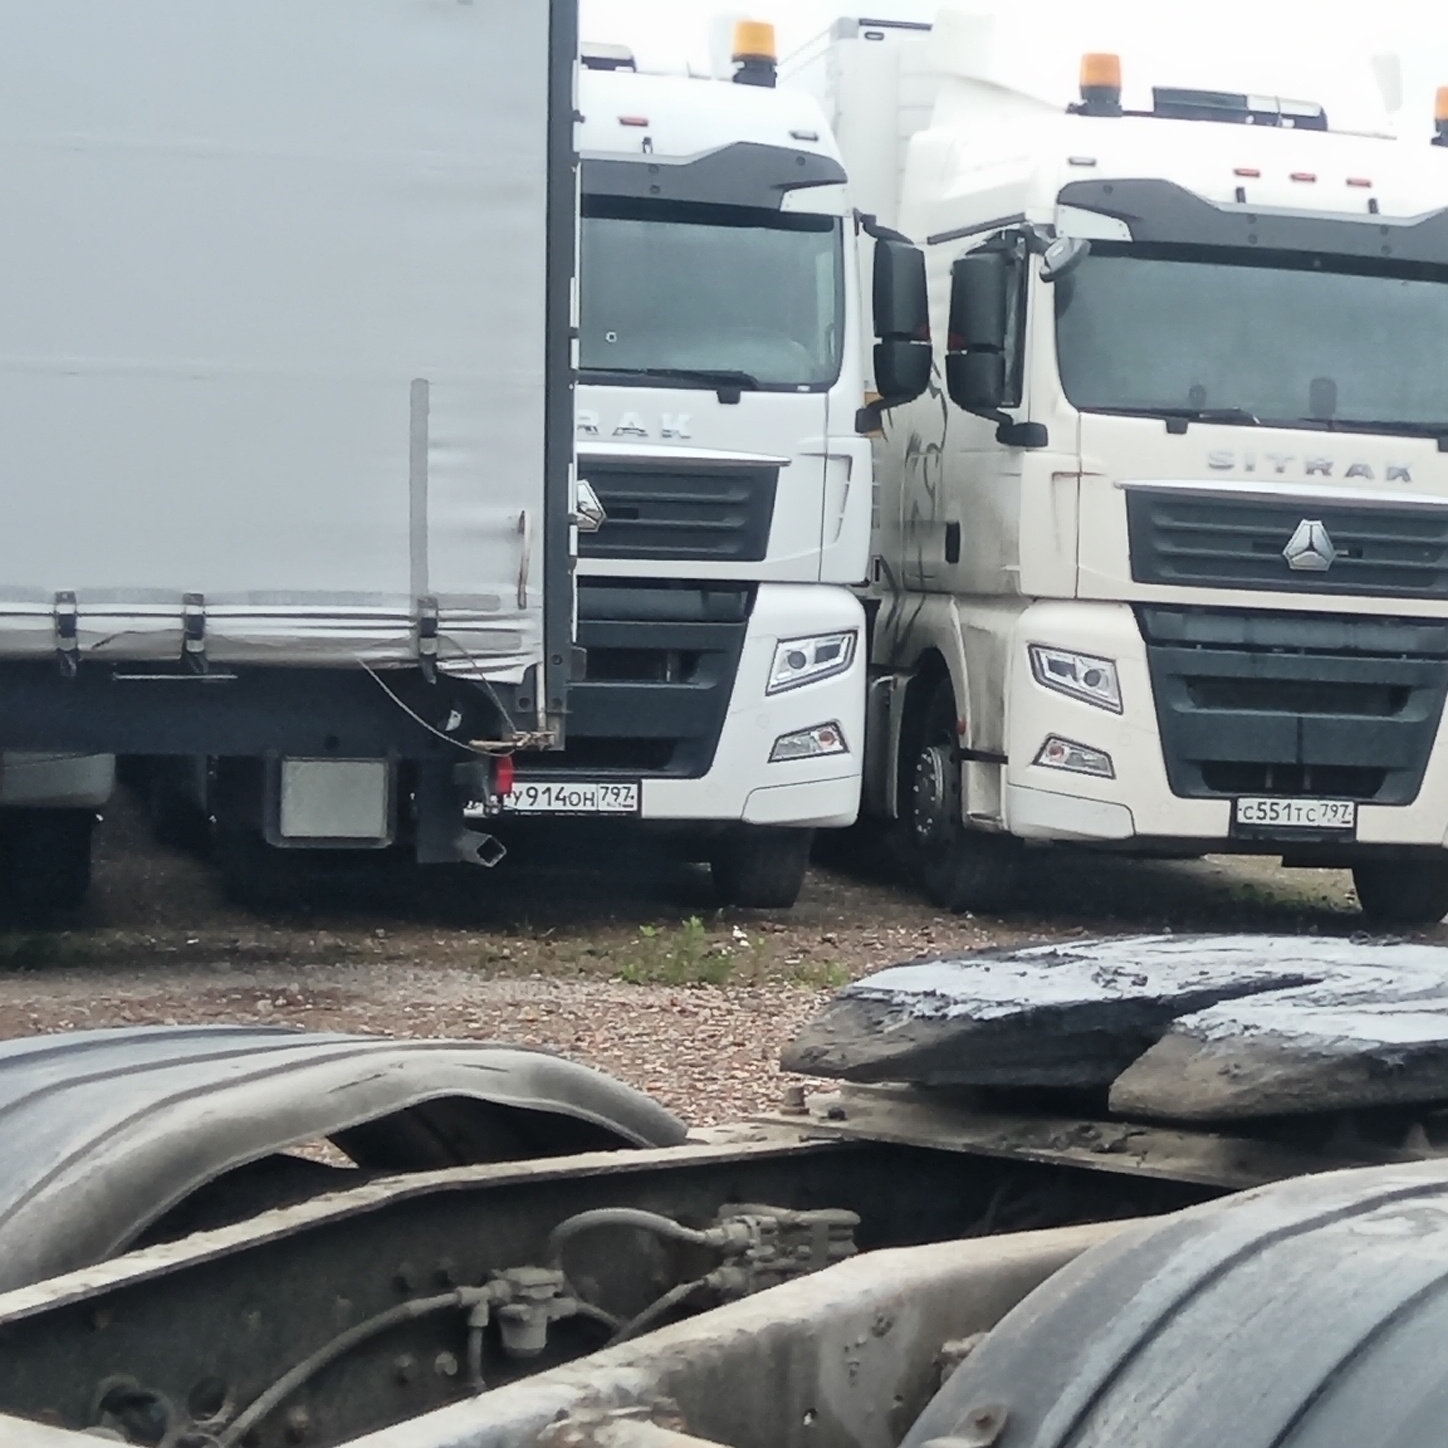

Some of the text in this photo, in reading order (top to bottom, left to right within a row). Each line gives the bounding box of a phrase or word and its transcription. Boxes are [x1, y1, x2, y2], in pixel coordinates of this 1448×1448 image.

[1207, 450, 1414, 483] SITRAK
[600, 786, 631, 802] 797
[1243, 802, 1350, 822] С551ТС 797
